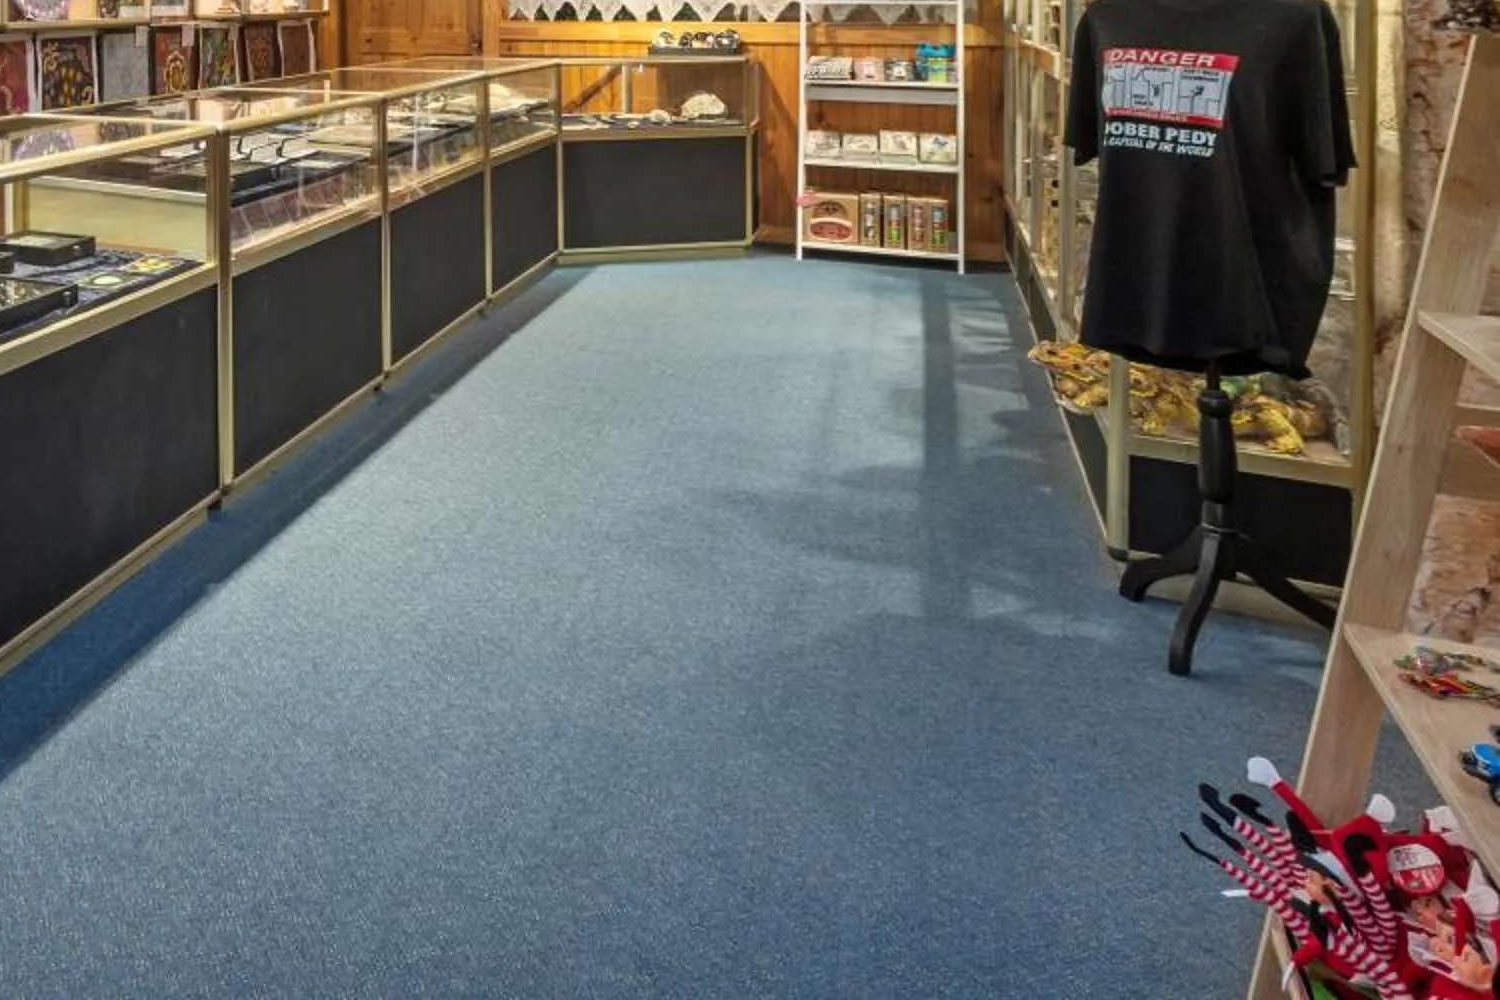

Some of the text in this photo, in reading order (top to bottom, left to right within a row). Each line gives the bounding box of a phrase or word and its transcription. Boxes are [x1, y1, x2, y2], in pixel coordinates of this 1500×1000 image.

[1109, 48, 1215, 67] DANGER
[1104, 121, 1217, 146] OBER PEDY
[1176, 144, 1215, 157] WORLD
